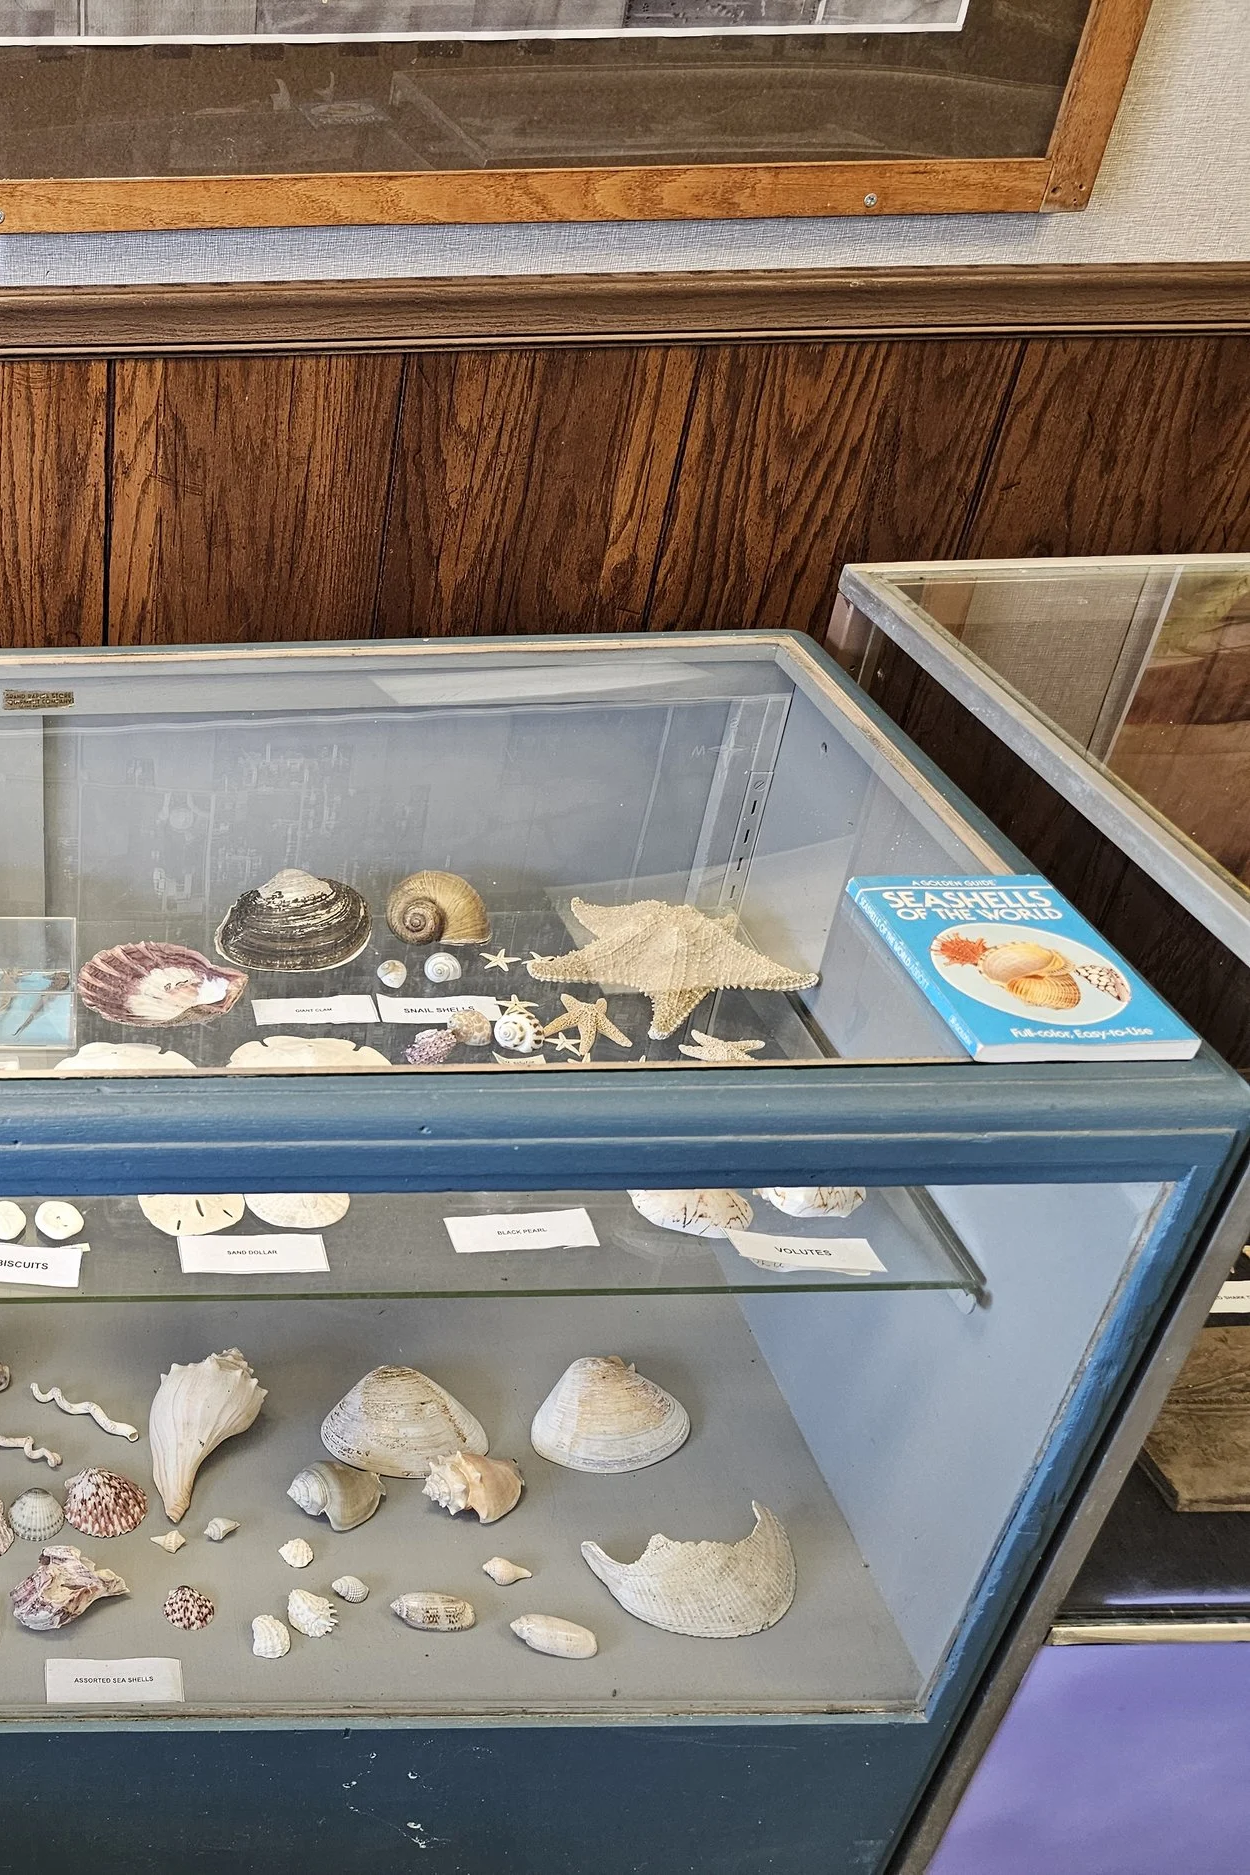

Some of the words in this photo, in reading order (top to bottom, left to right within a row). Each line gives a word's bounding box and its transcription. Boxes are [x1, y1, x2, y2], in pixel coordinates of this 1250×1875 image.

[882, 890, 1052, 908] SEASHELLS
[897, 908, 927, 921] OF
[932, 908, 976, 921] THE
[975, 908, 1063, 921] WORLD
[1074, 1027, 1154, 1042] Easy-to-Use
[774, 1246, 832, 1256] VOLUTES
[112, 1676, 127, 1684] SEA
[127, 1675, 154, 1684] SHELLS
